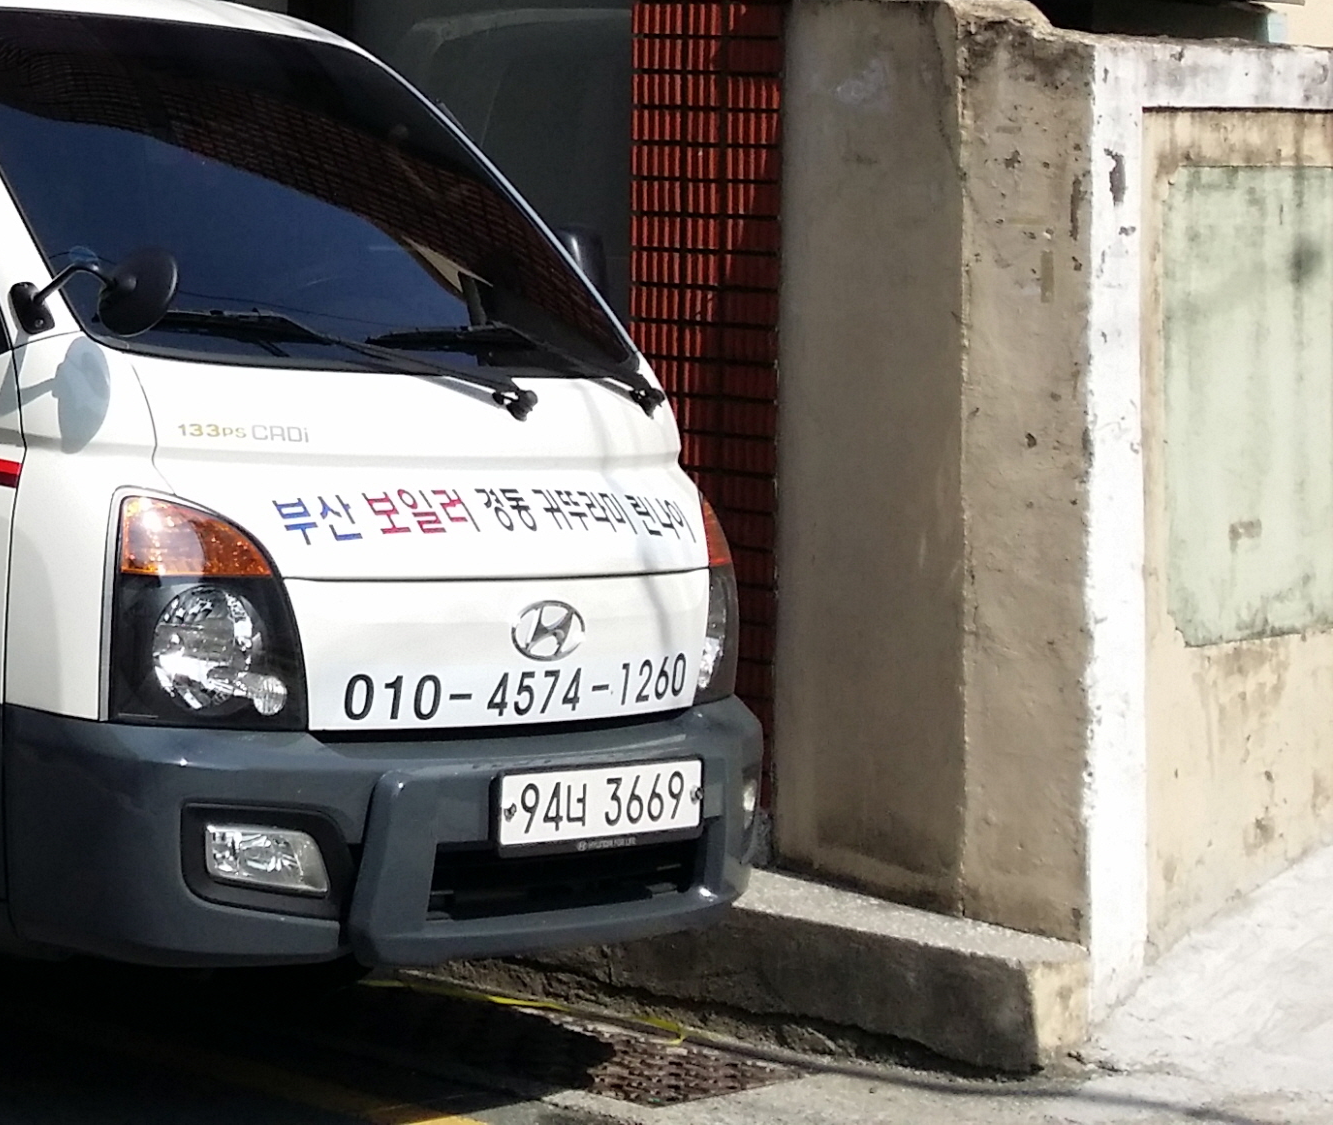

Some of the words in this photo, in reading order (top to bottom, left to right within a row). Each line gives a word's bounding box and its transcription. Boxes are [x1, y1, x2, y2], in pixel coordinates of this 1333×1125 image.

[251, 424, 310, 443] CRDi
[272, 494, 362, 545] 부산
[362, 488, 481, 534] 보일러
[475, 488, 537, 532] 경동
[532, 488, 638, 536] 귀뚜라미
[626, 493, 697, 543] 린나이
[520, 781, 587, 835] 94너
[604, 770, 684, 827] 3669
